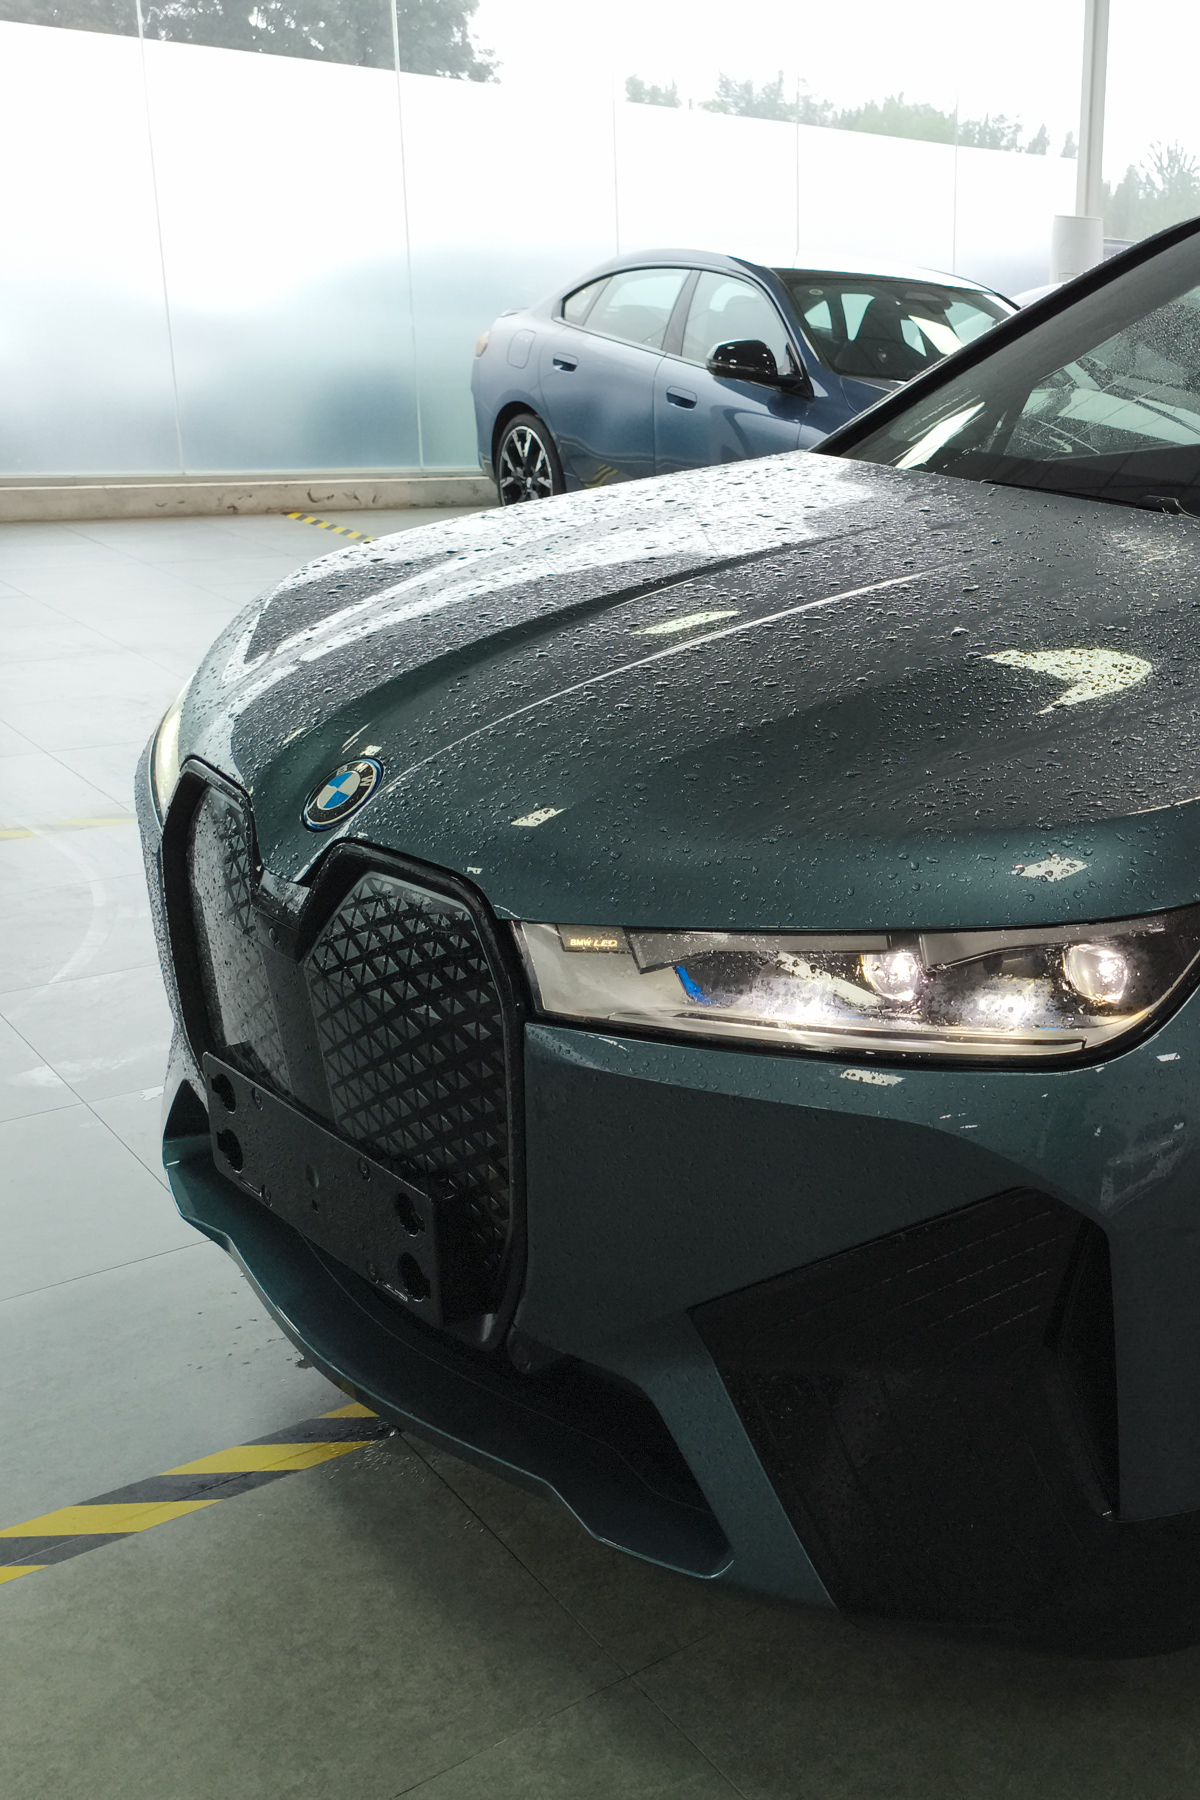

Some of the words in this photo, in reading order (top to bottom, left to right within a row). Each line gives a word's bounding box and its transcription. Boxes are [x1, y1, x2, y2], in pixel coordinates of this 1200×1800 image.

[335, 762, 374, 787] BMW
[570, 938, 592, 946] BMW
[593, 939, 618, 947] LED
